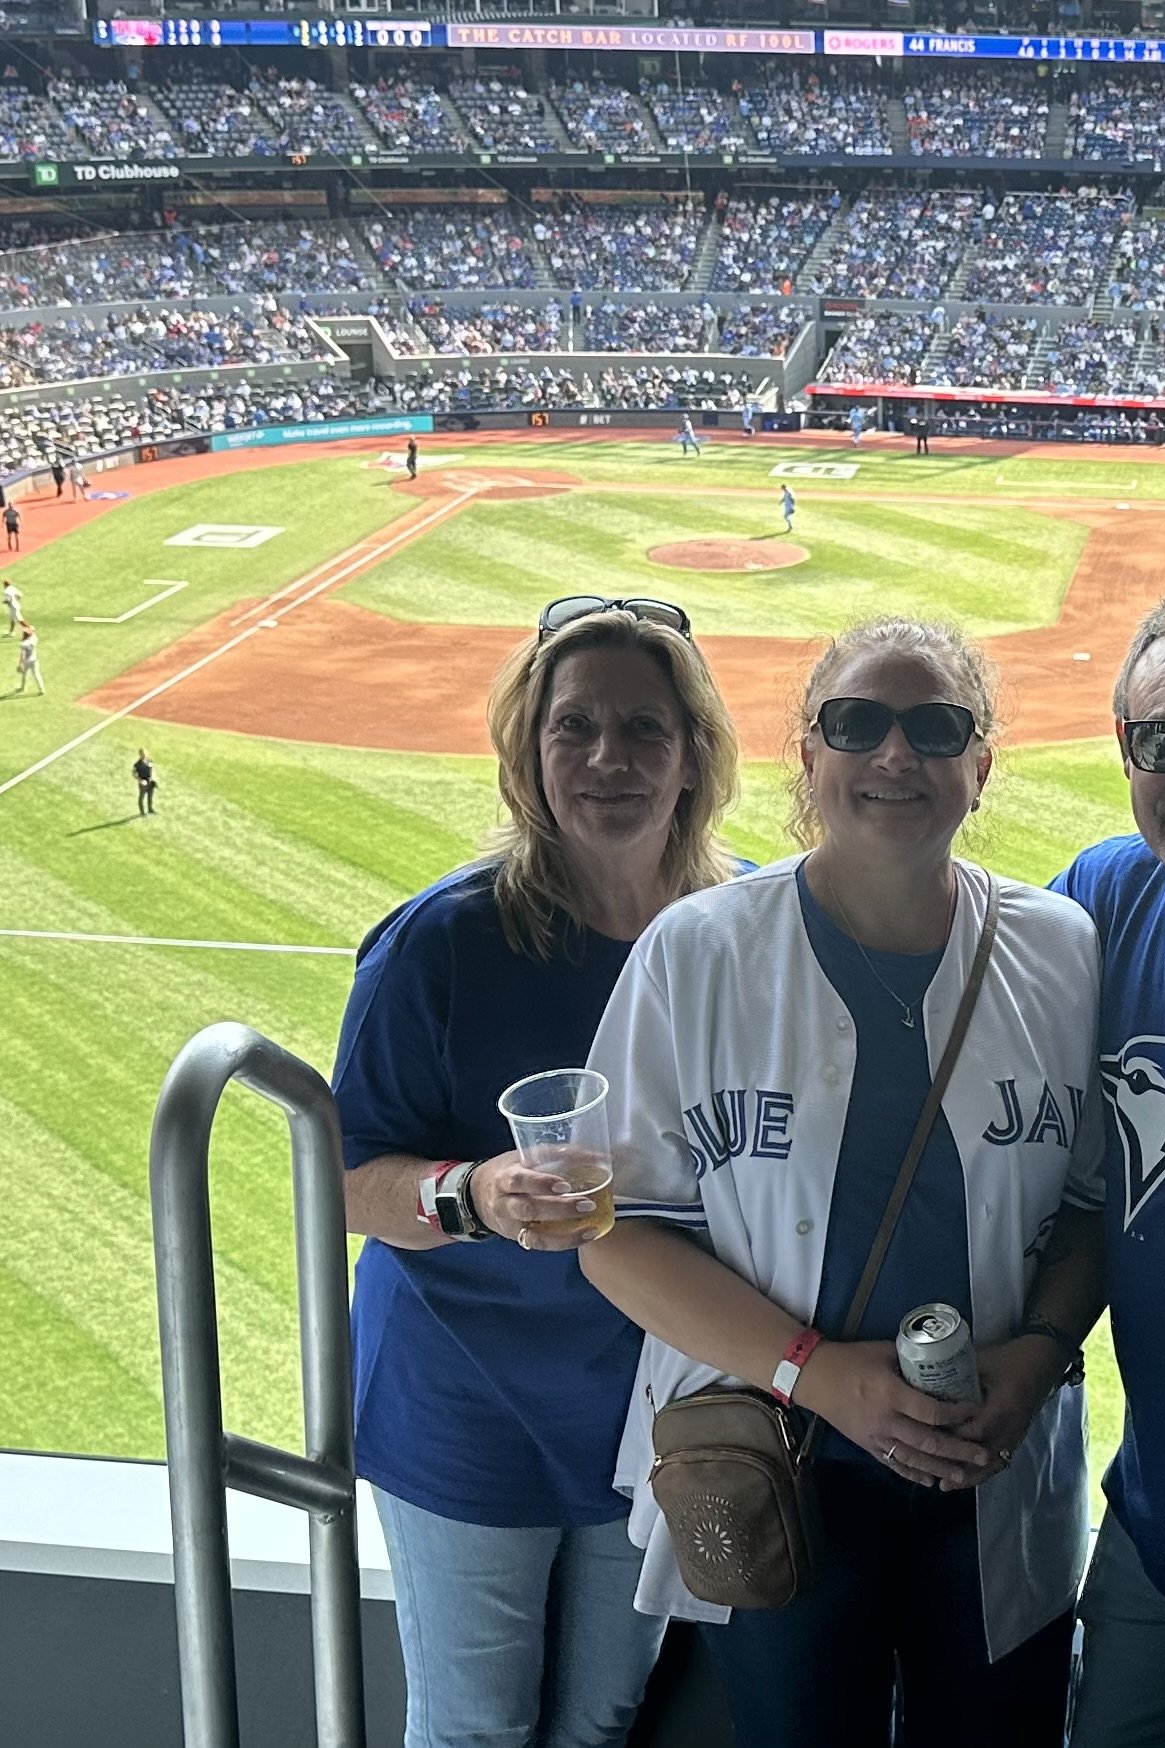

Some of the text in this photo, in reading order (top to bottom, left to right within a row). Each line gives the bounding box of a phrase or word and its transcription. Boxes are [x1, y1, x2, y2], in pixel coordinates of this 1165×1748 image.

[458, 29, 499, 43] THE
[508, 30, 572, 44] CATCH
[582, 31, 621, 45] BAR
[631, 33, 717, 48] LOCATED
[726, 34, 748, 48] RF
[844, 38, 896, 50] ROGERS
[908, 38, 976, 53] 44 FRANCIS
[74, 163, 180, 181] TD Clubhouse
[306, 425, 330, 436] travel
[330, 426, 349, 435] even
[684, 1089, 796, 1181] LUE
